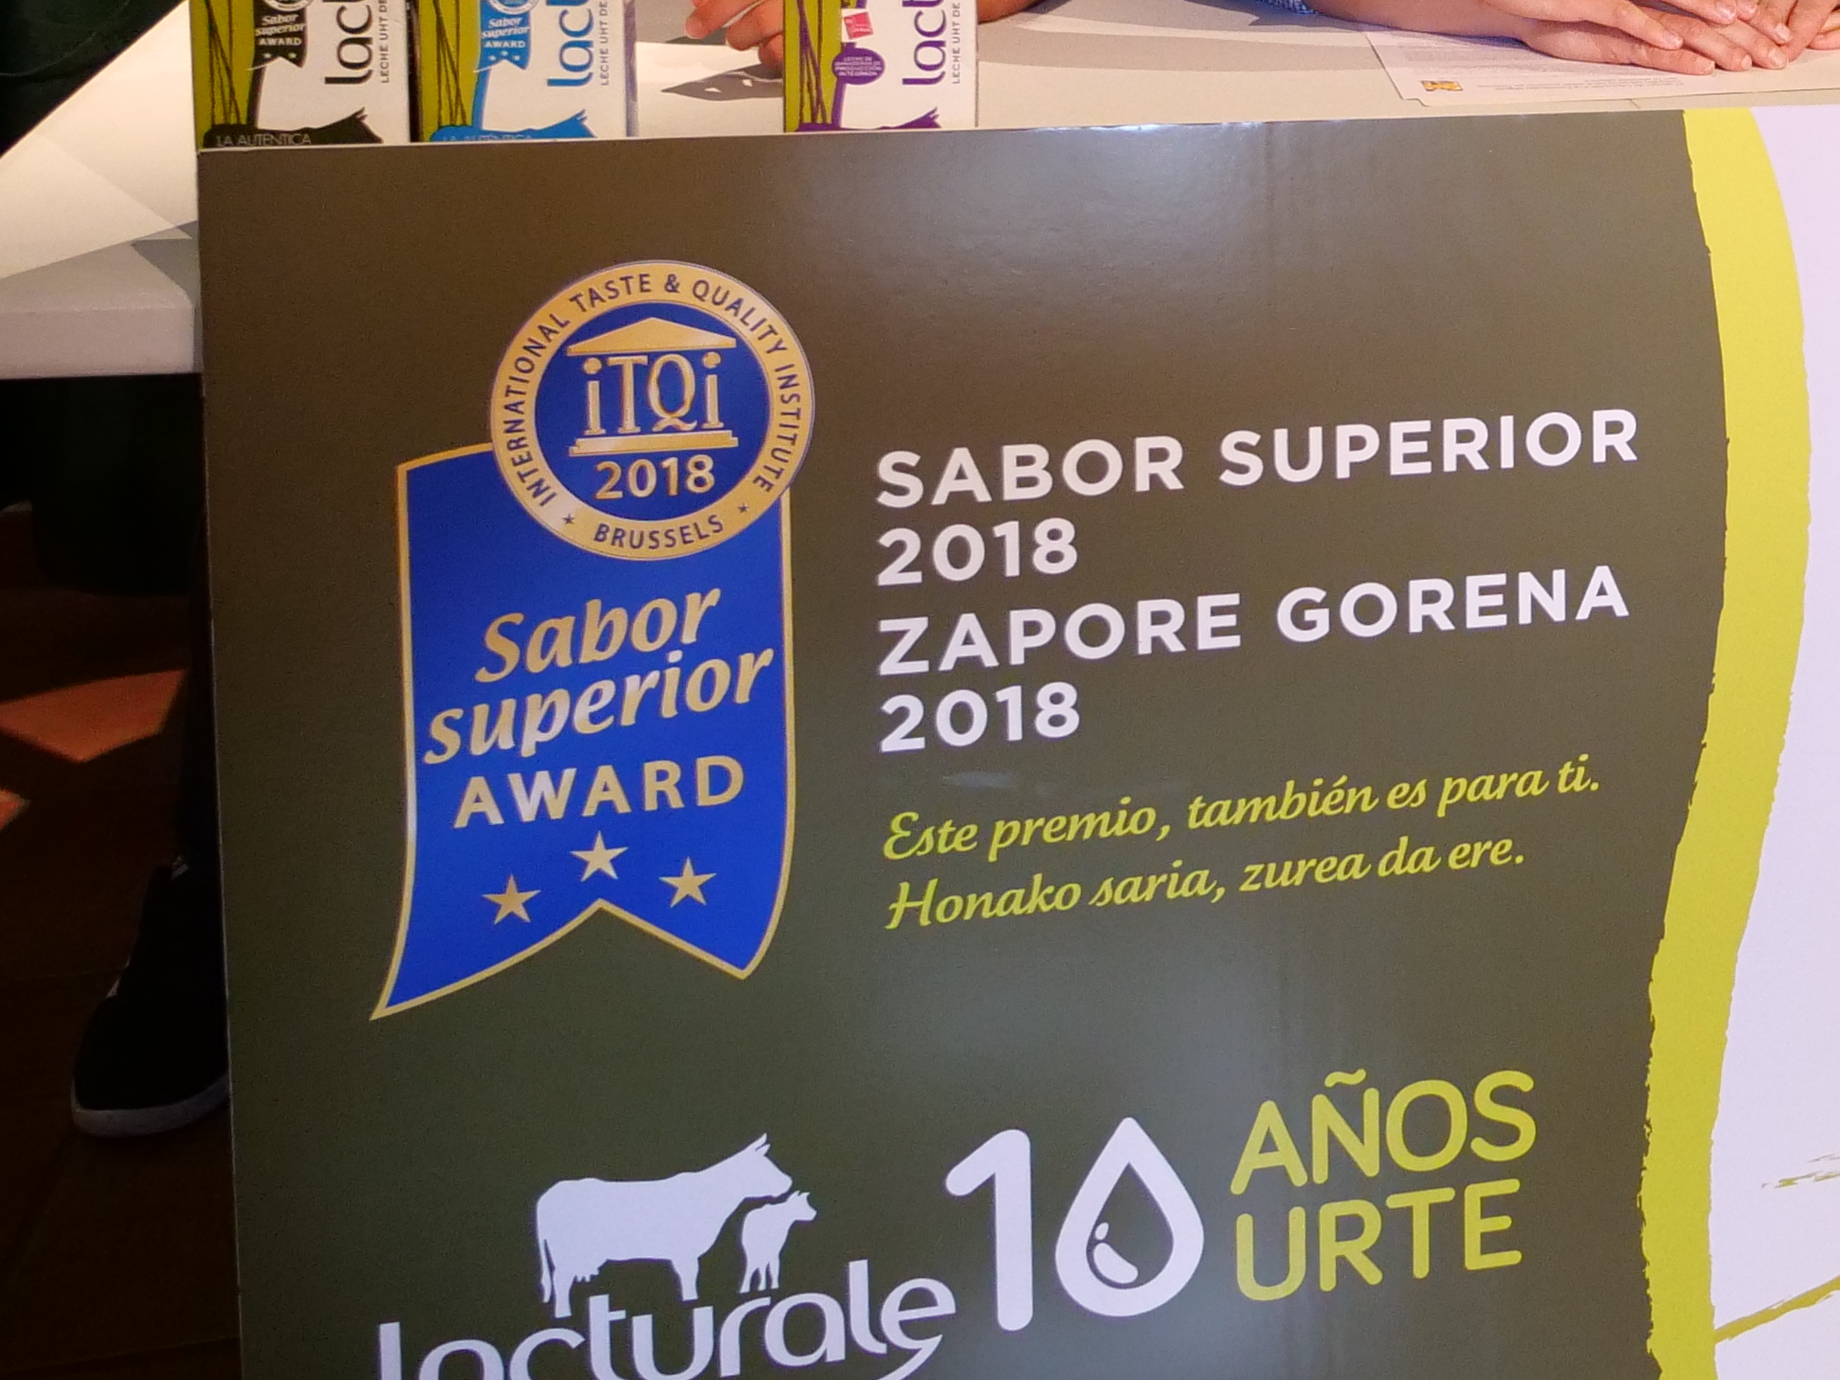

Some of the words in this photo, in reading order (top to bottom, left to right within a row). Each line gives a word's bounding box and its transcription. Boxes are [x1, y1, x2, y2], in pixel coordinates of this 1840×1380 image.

[502, 311, 571, 507] INTERNATIONAL
[569, 272, 653, 314] TASTE
[663, 272, 681, 295] &
[691, 279, 788, 356] QUALITY
[752, 363, 802, 495] INSTITUTE
[582, 351, 725, 437] iTQi
[594, 454, 716, 500] 2018
[876, 434, 1185, 509] SABOR
[1219, 407, 1639, 488] SUPERIOR
[593, 513, 725, 551] BRUSSELS
[876, 516, 1079, 587] 2018
[474, 587, 721, 683] Sabor
[877, 593, 1243, 676] ZAPORE
[1277, 564, 1631, 645] GORENA
[424, 648, 774, 765] superior
[880, 681, 1081, 754] 2018
[453, 754, 745, 830] AWARD
[883, 810, 980, 861] Este
[988, 795, 1170, 863] premio,
[1187, 775, 1379, 834] también
[1386, 781, 1429, 809] es
[1437, 769, 1549, 819] para
[1556, 753, 1602, 794] ti.
[883, 878, 1081, 930] Honako
[1089, 859, 1226, 905] saria,
[1240, 851, 1371, 893] zurea
[1377, 835, 1441, 880] da
[1447, 836, 1526, 868] ere.
[1230, 1068, 1540, 1197] AÑOS
[1233, 1178, 1524, 1303] URTE
[377, 1259, 957, 1380] lacturale
